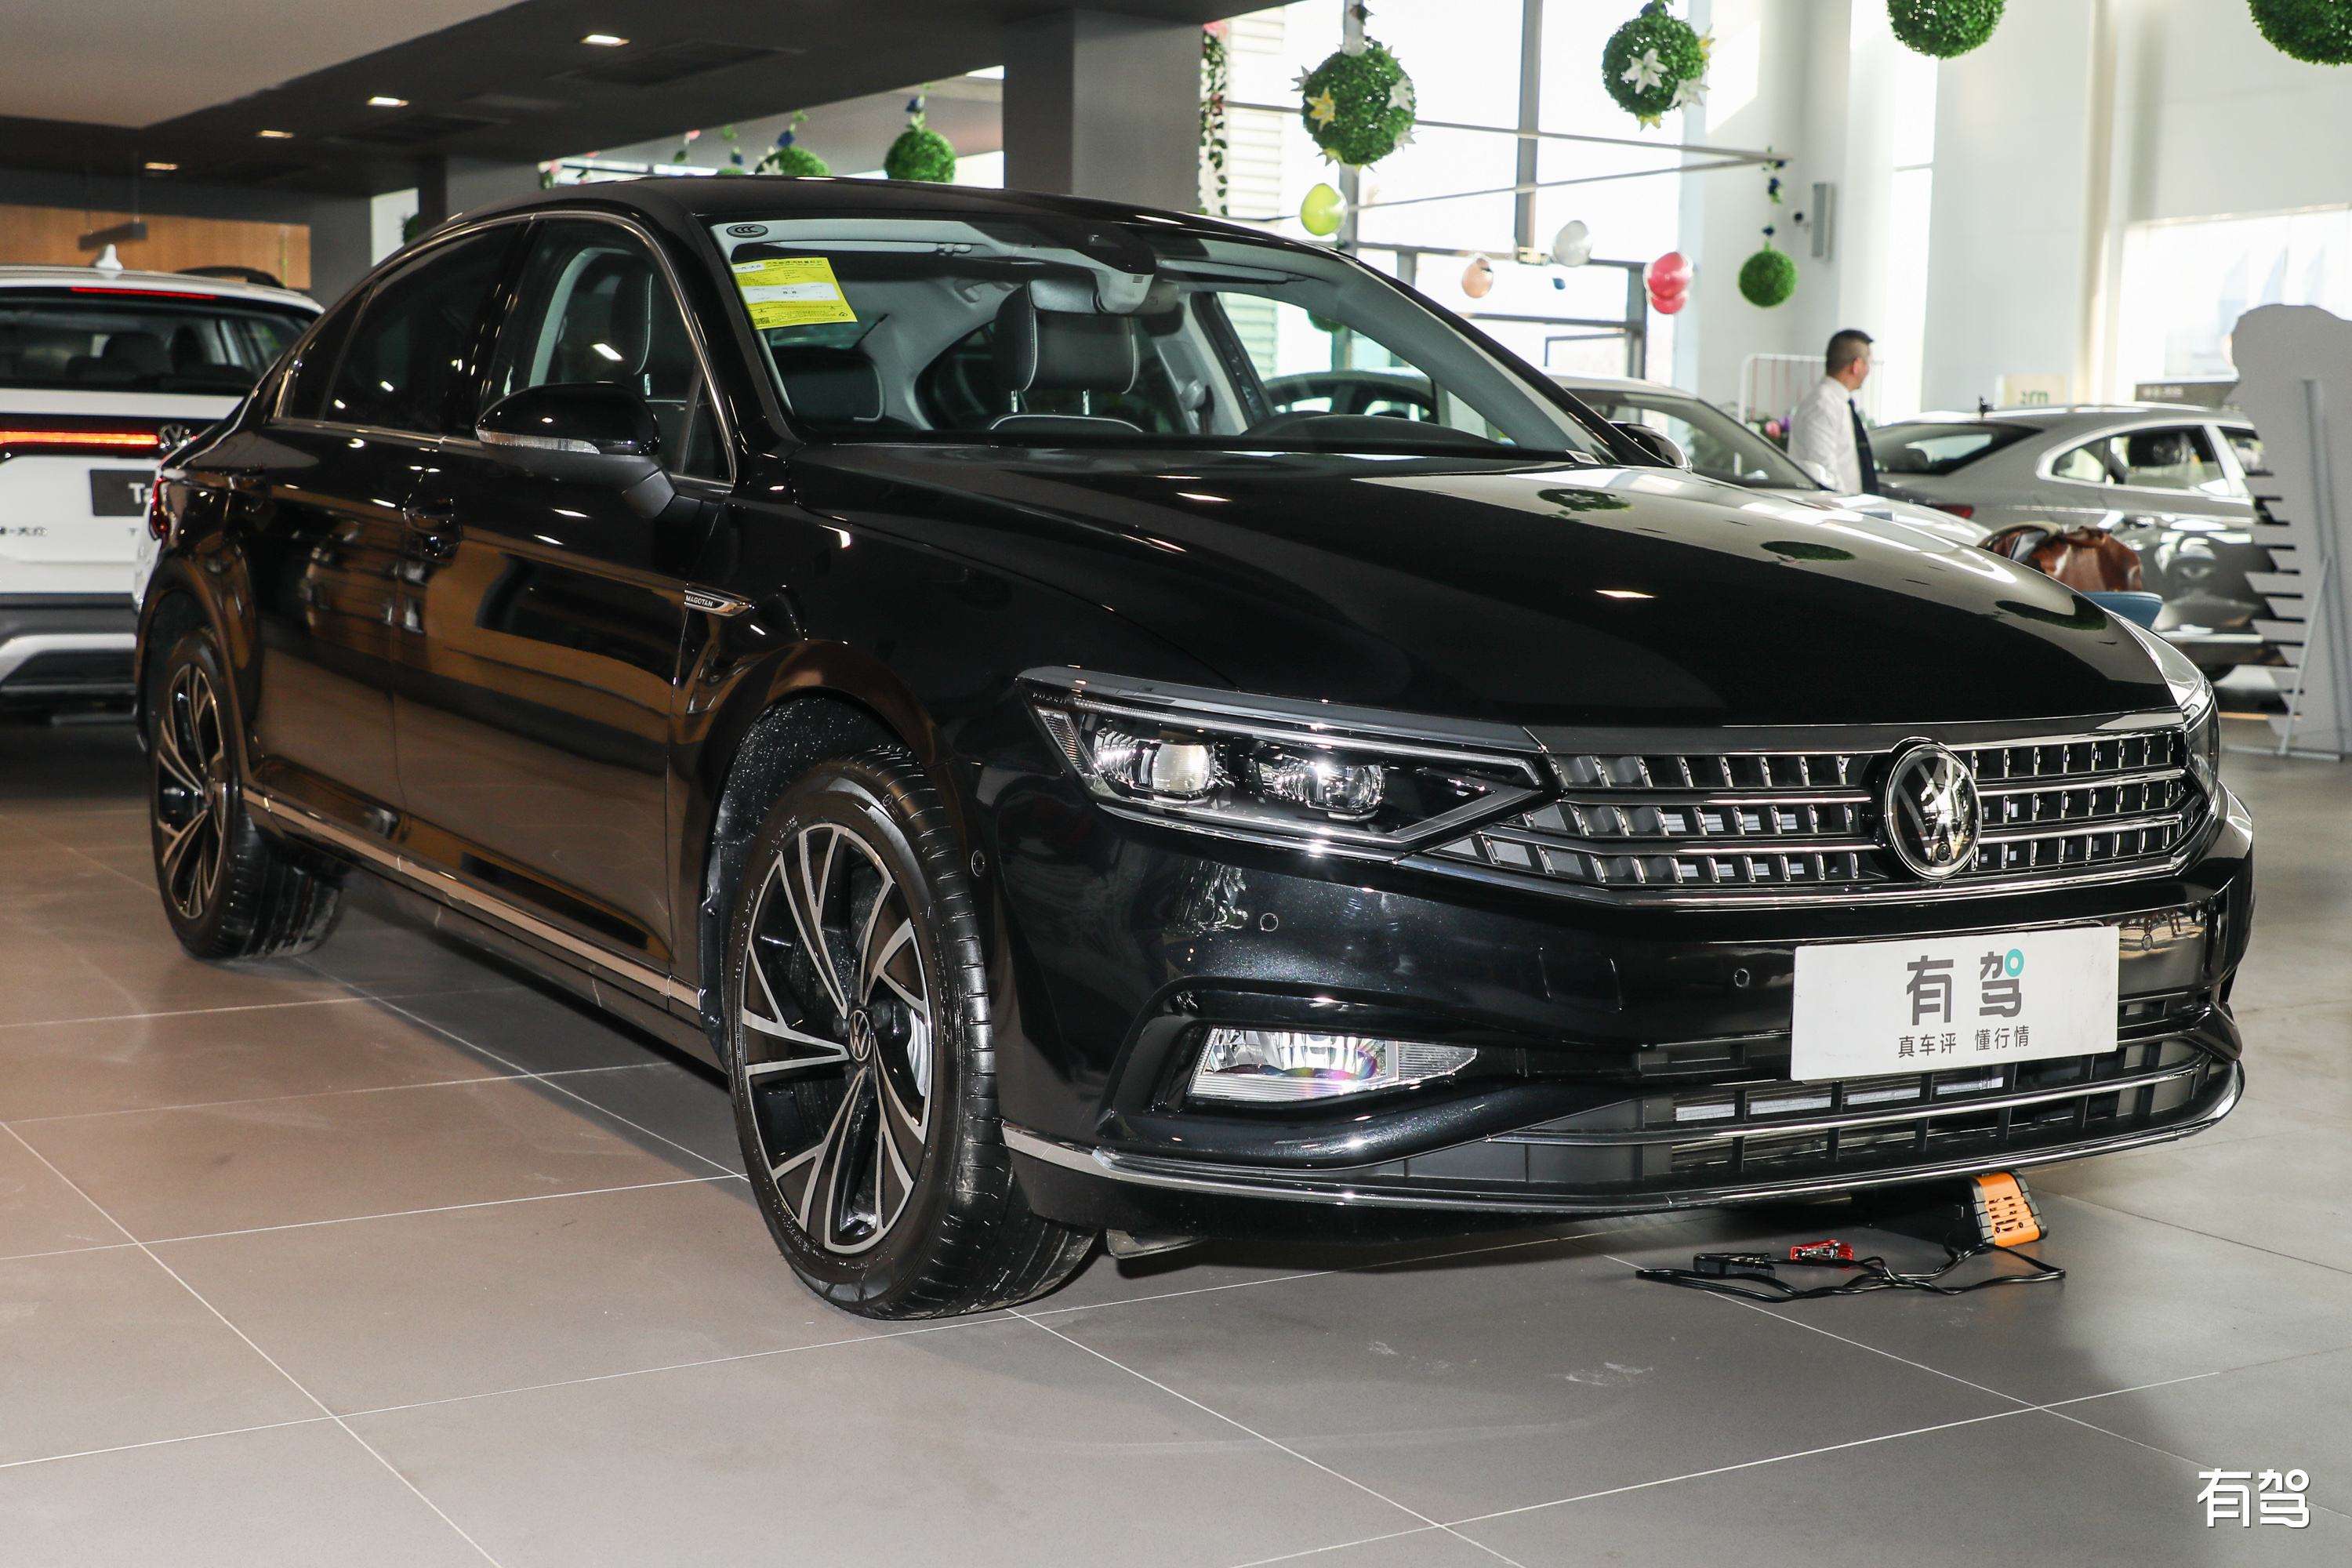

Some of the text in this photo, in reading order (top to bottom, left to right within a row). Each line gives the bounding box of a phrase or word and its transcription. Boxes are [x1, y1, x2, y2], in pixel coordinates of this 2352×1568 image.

[685, 595, 713, 608] MAGOTAN
[1906, 948, 2024, 1025] 有驾
[1897, 1025, 2030, 1058] 真车评 懂行情
